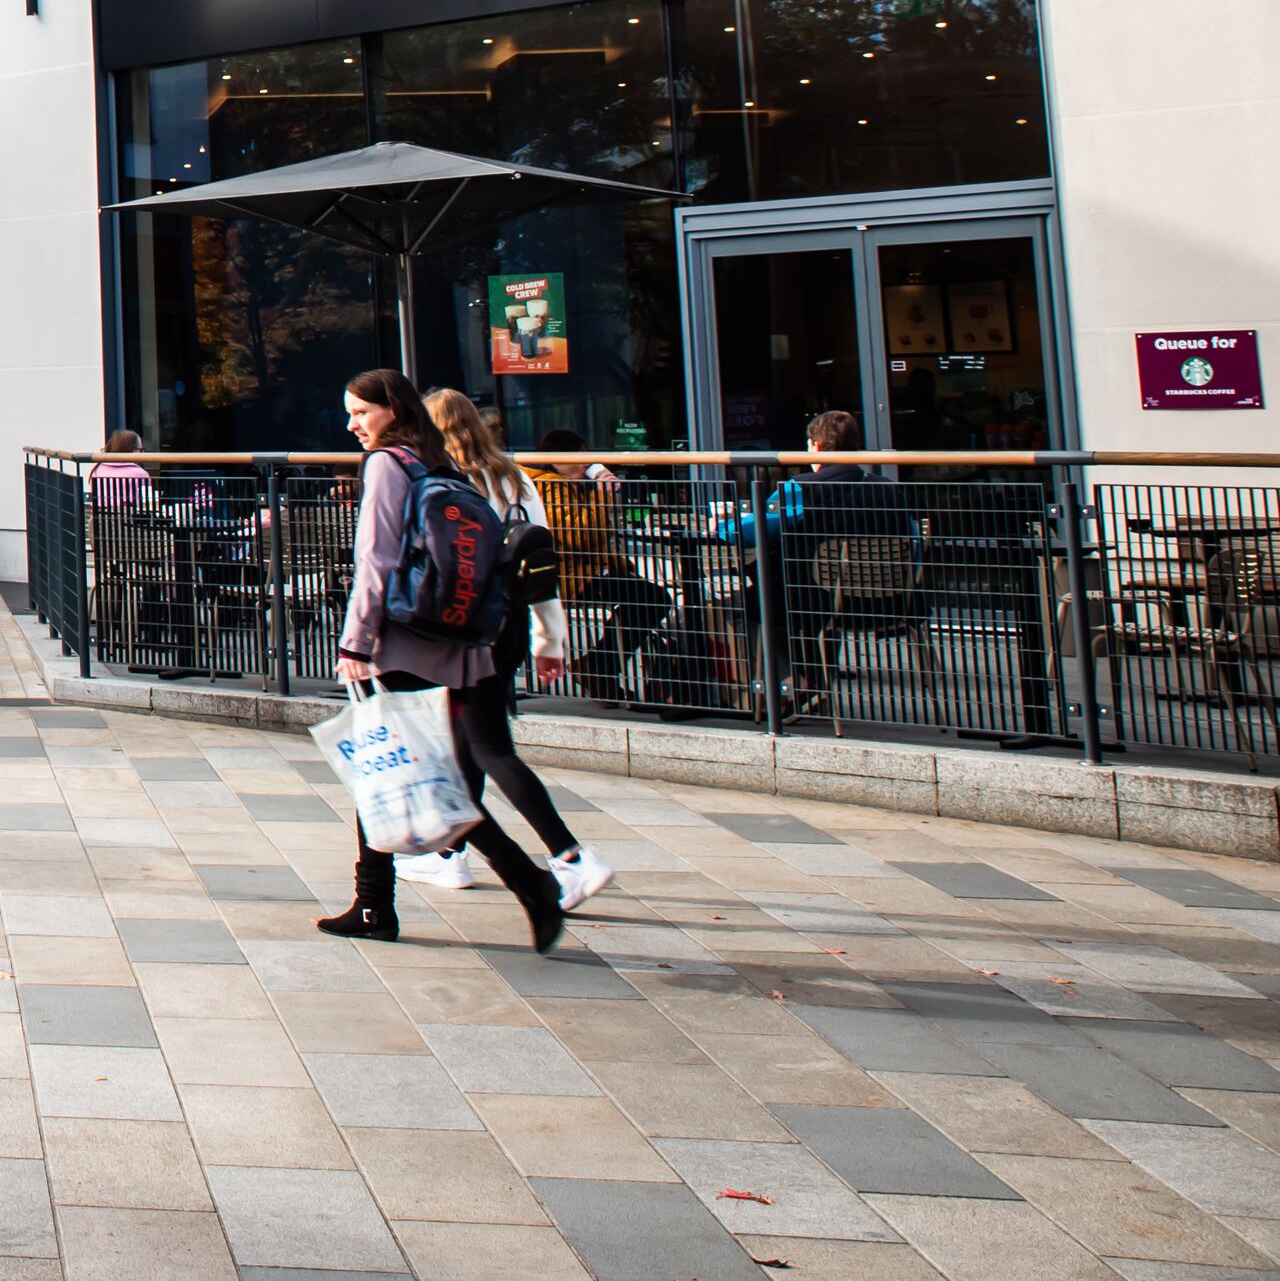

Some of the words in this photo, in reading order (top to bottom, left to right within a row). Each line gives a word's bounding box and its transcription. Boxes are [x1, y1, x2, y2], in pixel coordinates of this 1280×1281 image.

[506, 284, 524, 292] COLD
[524, 280, 545, 289] BREW
[515, 289, 538, 299] CREW
[1154, 338, 1208, 350] Queue
[1211, 336, 1237, 349] for
